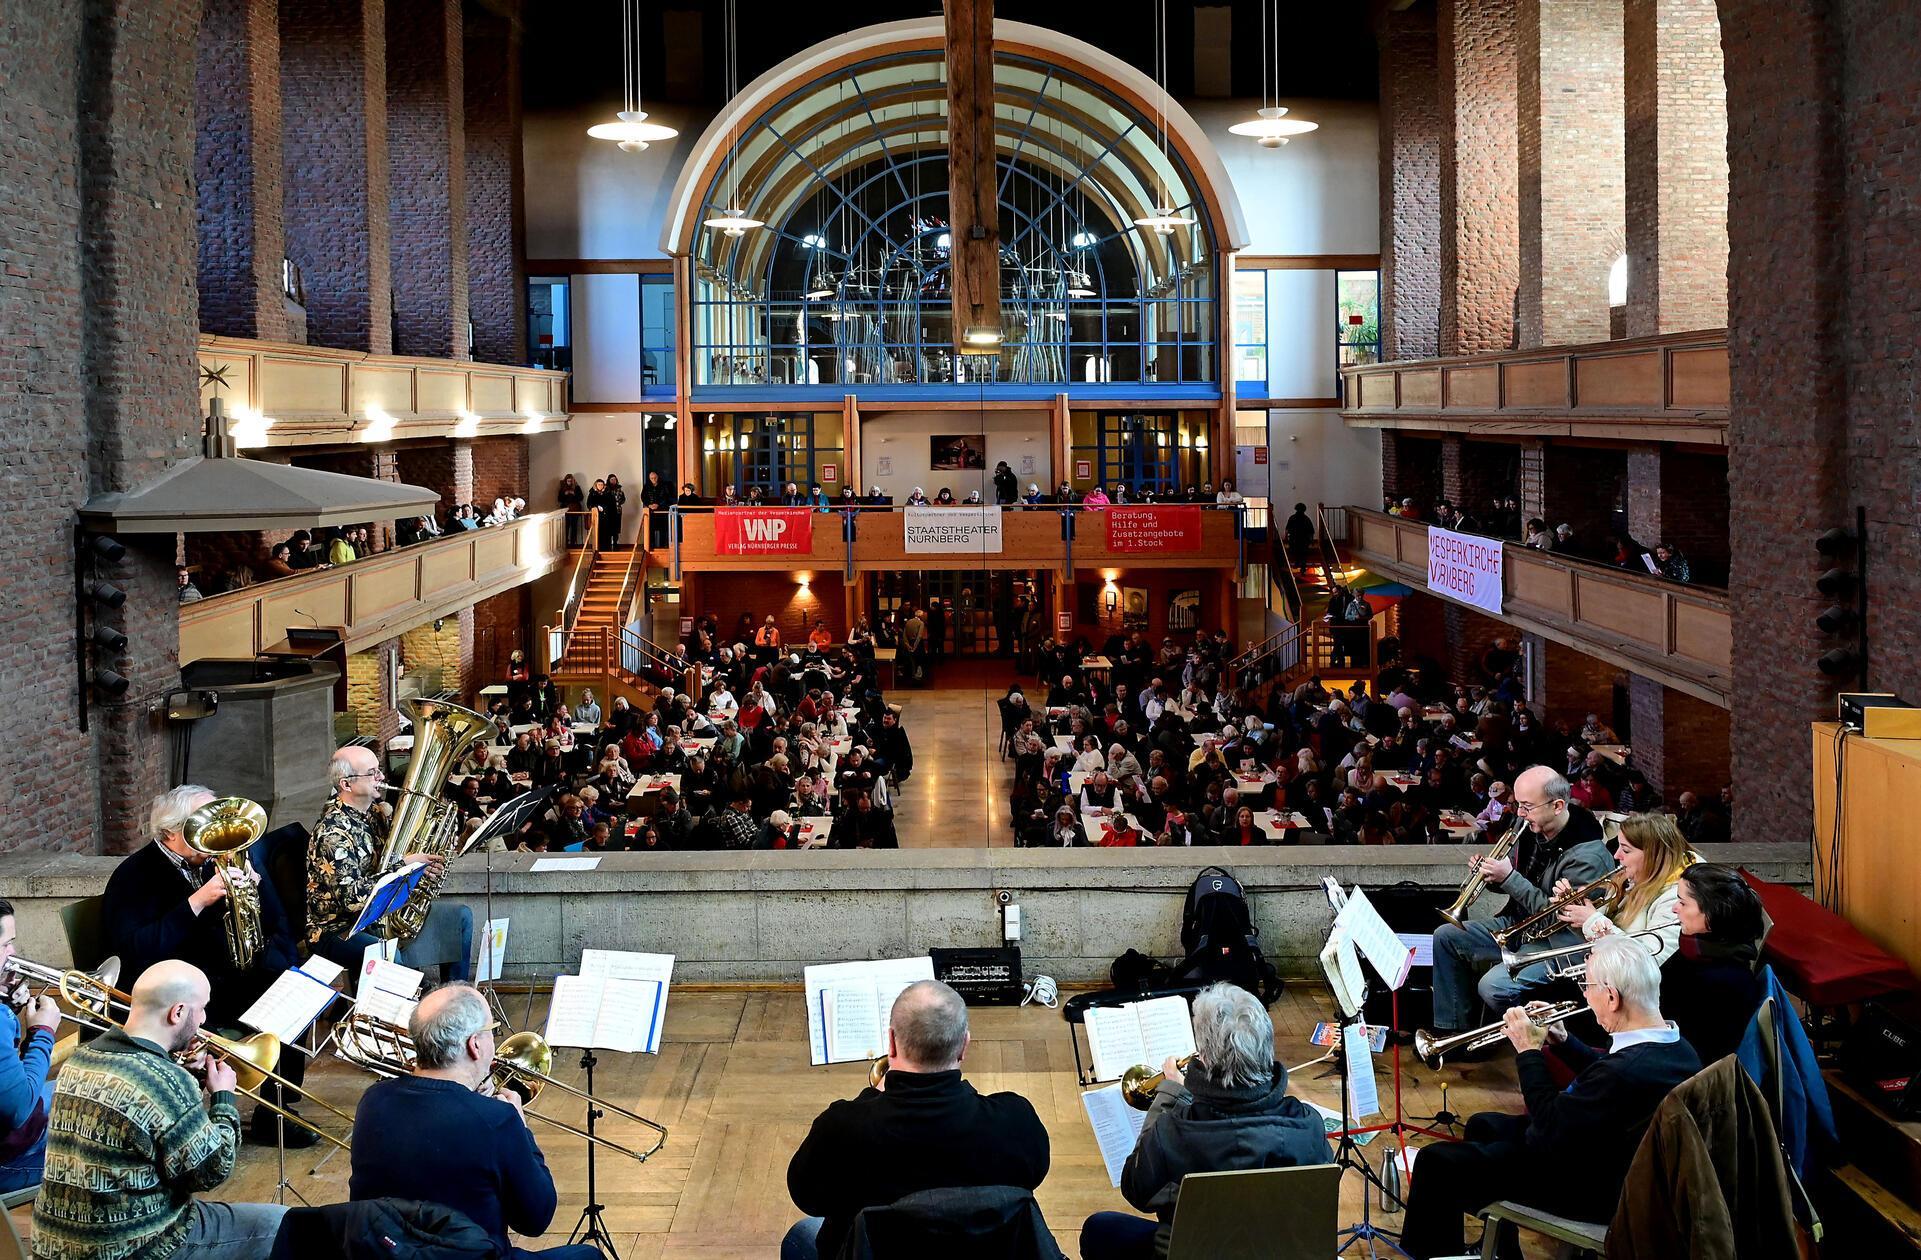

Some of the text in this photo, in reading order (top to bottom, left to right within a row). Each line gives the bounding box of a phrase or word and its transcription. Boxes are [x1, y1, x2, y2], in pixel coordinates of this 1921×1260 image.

[1111, 511, 1157, 520] Beratung,
[743, 518, 787, 541] VNP
[1111, 521, 1138, 529] Hilfe
[907, 525, 998, 535] STAATSTHEATER
[1112, 530, 1184, 539] Zusatzangebote
[908, 534, 970, 543] NÜRNBERG
[1882, 1028, 1906, 1047] CUBE
